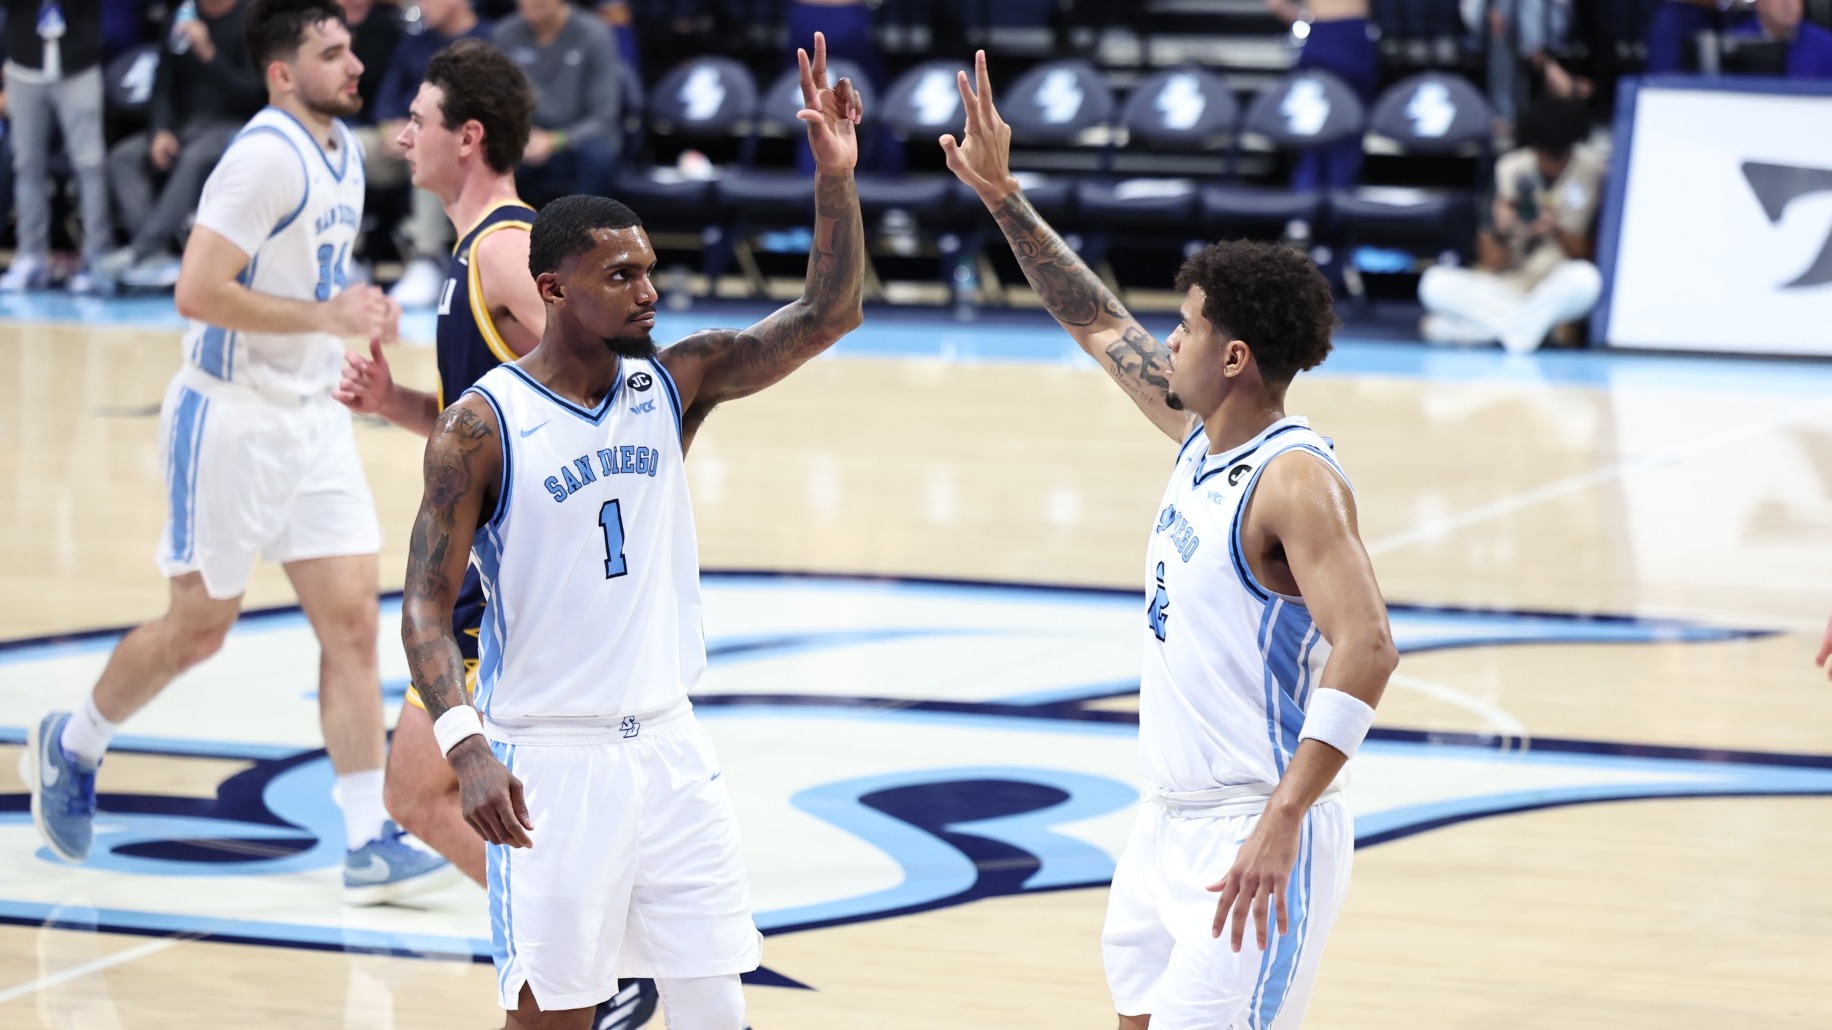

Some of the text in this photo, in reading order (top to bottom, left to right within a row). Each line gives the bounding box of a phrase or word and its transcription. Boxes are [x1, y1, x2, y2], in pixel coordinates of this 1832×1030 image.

[632, 373, 650, 388] JC
[629, 399, 656, 415] WCC
[544, 445, 660, 503] SAN DIEGO
[598, 498, 628, 580] 1
